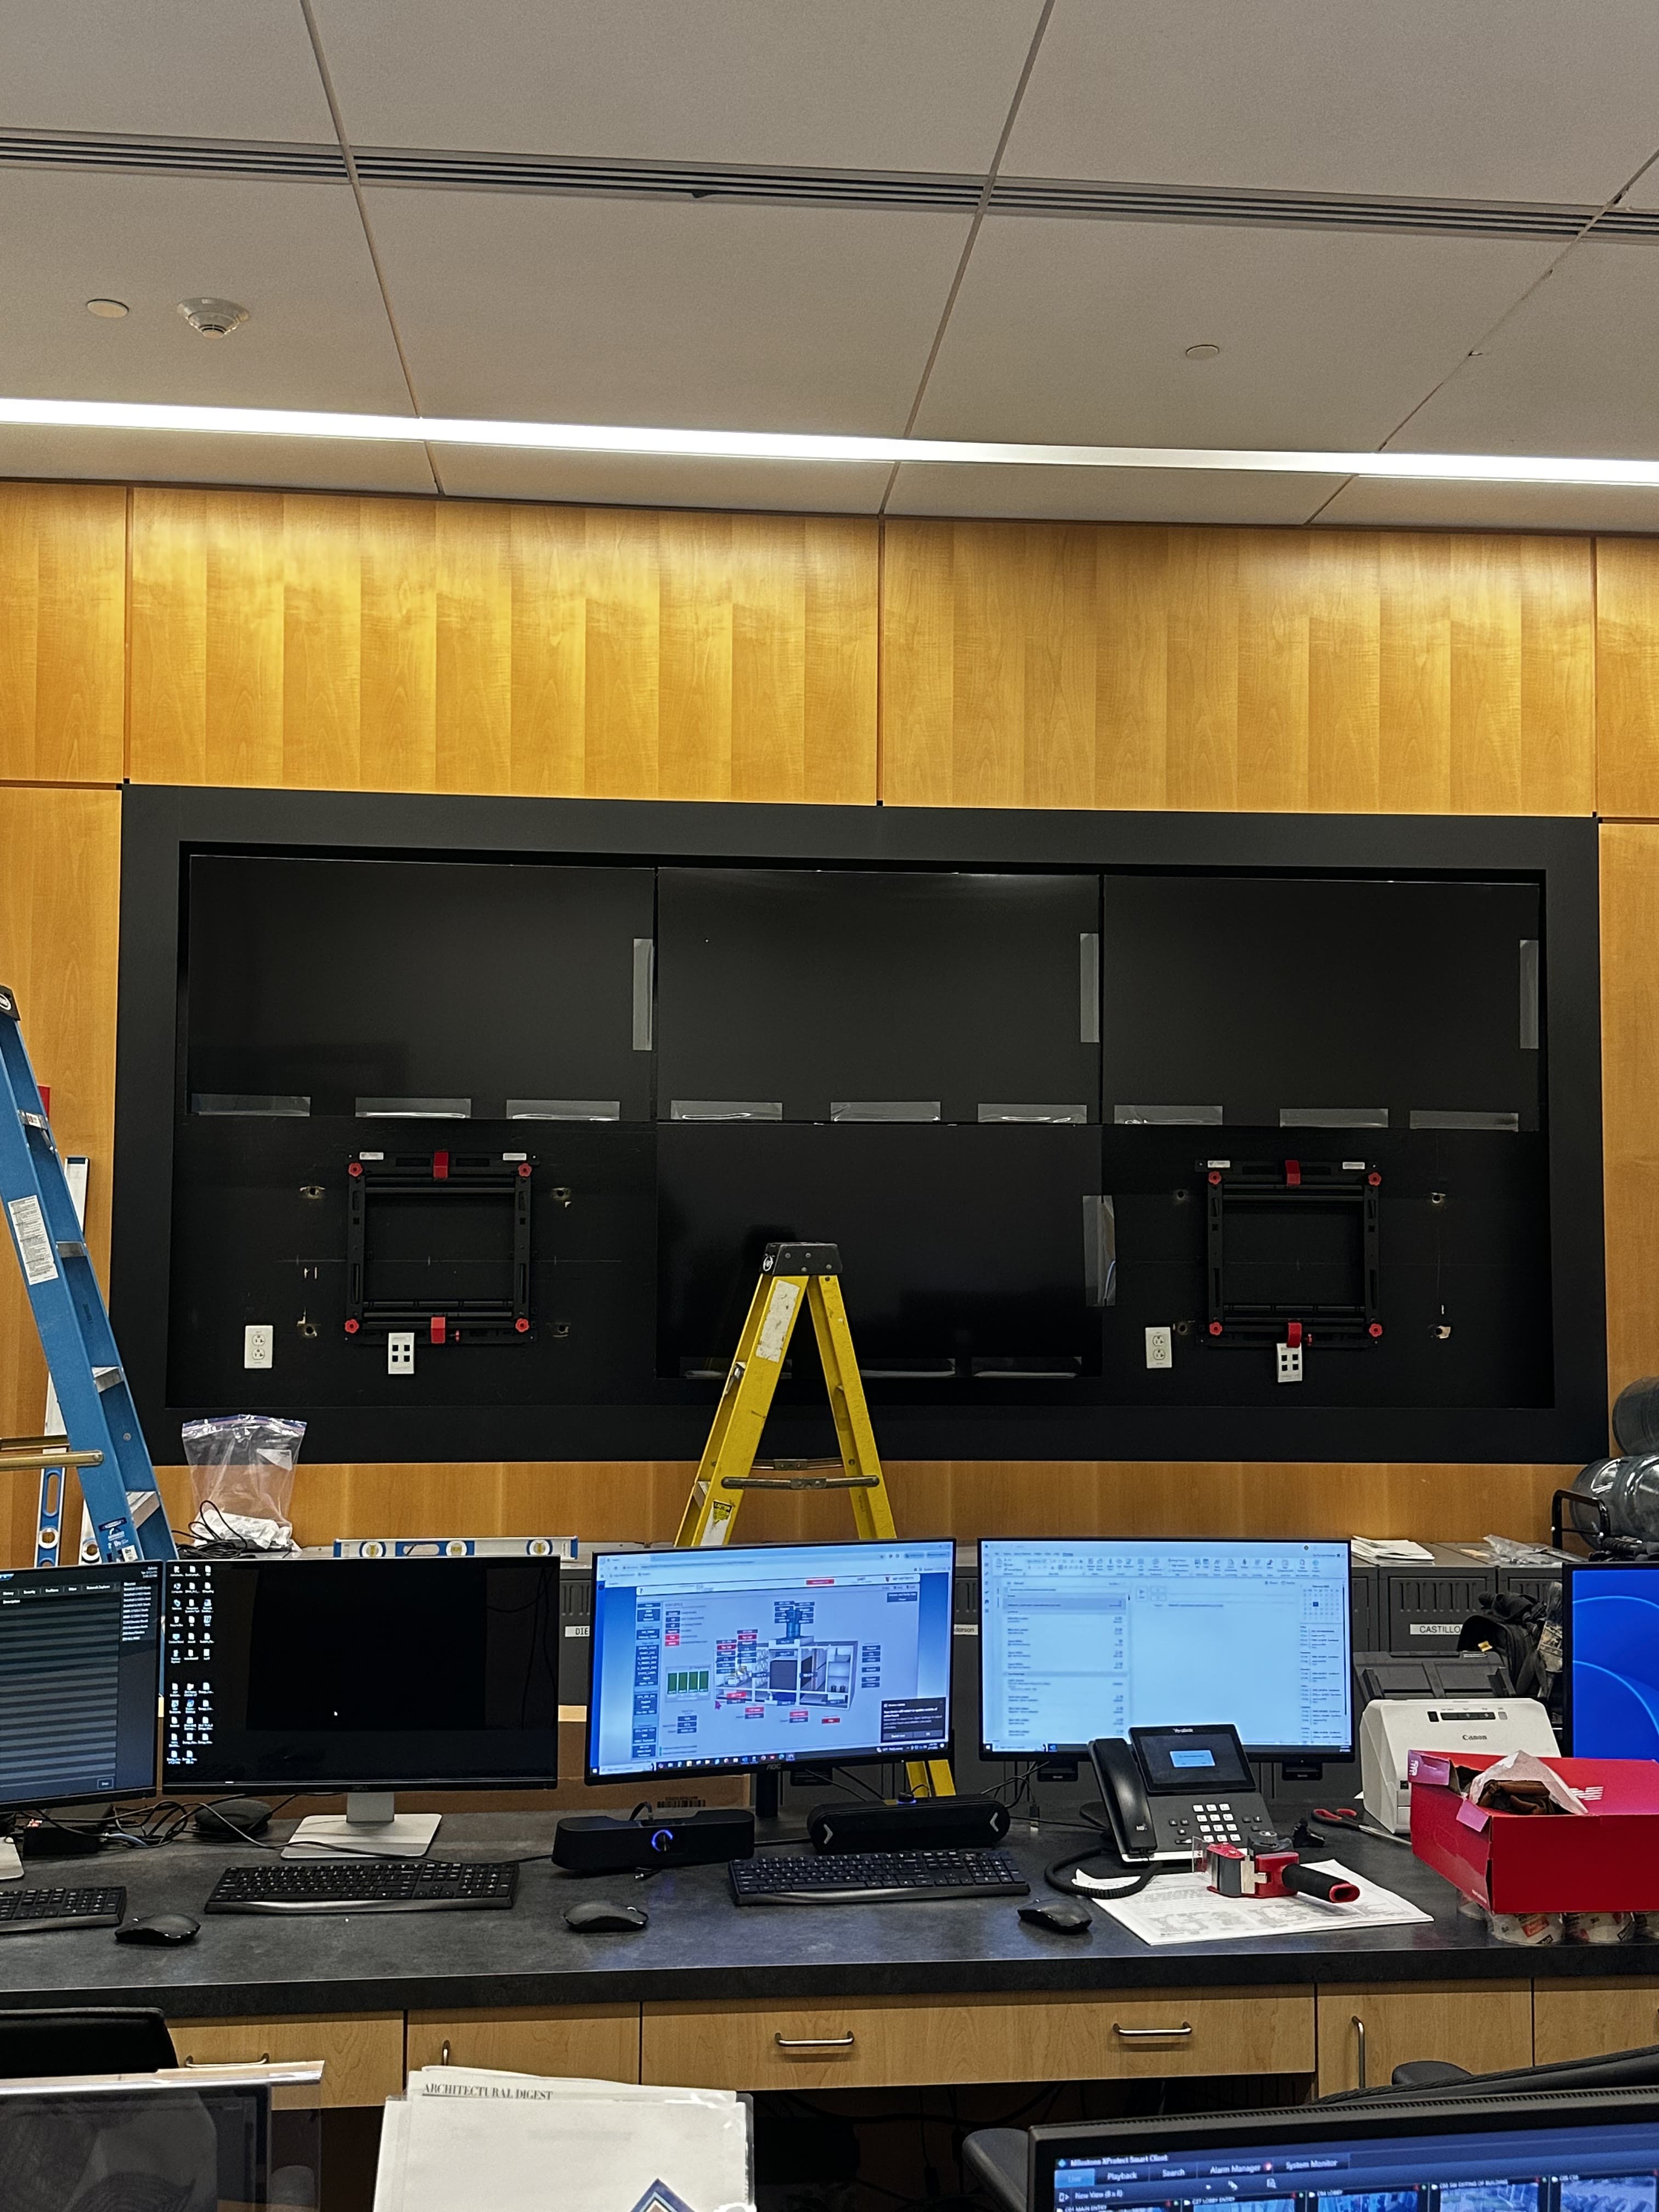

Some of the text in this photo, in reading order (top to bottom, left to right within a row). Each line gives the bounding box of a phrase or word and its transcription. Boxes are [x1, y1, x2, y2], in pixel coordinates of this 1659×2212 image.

[424, 2083, 554, 2101] ARCHITECTURAL DIGEST
[1102, 2157, 1128, 2165] XProtect
[1130, 2155, 1148, 2164] Smart
[1149, 2154, 1168, 2162] Client
[1210, 2164, 1261, 2174] Alarm Manager
[1286, 2159, 1338, 2171] System Monitor
[1107, 2171, 1137, 2181] Playback
[1162, 2168, 1185, 2177] Search
